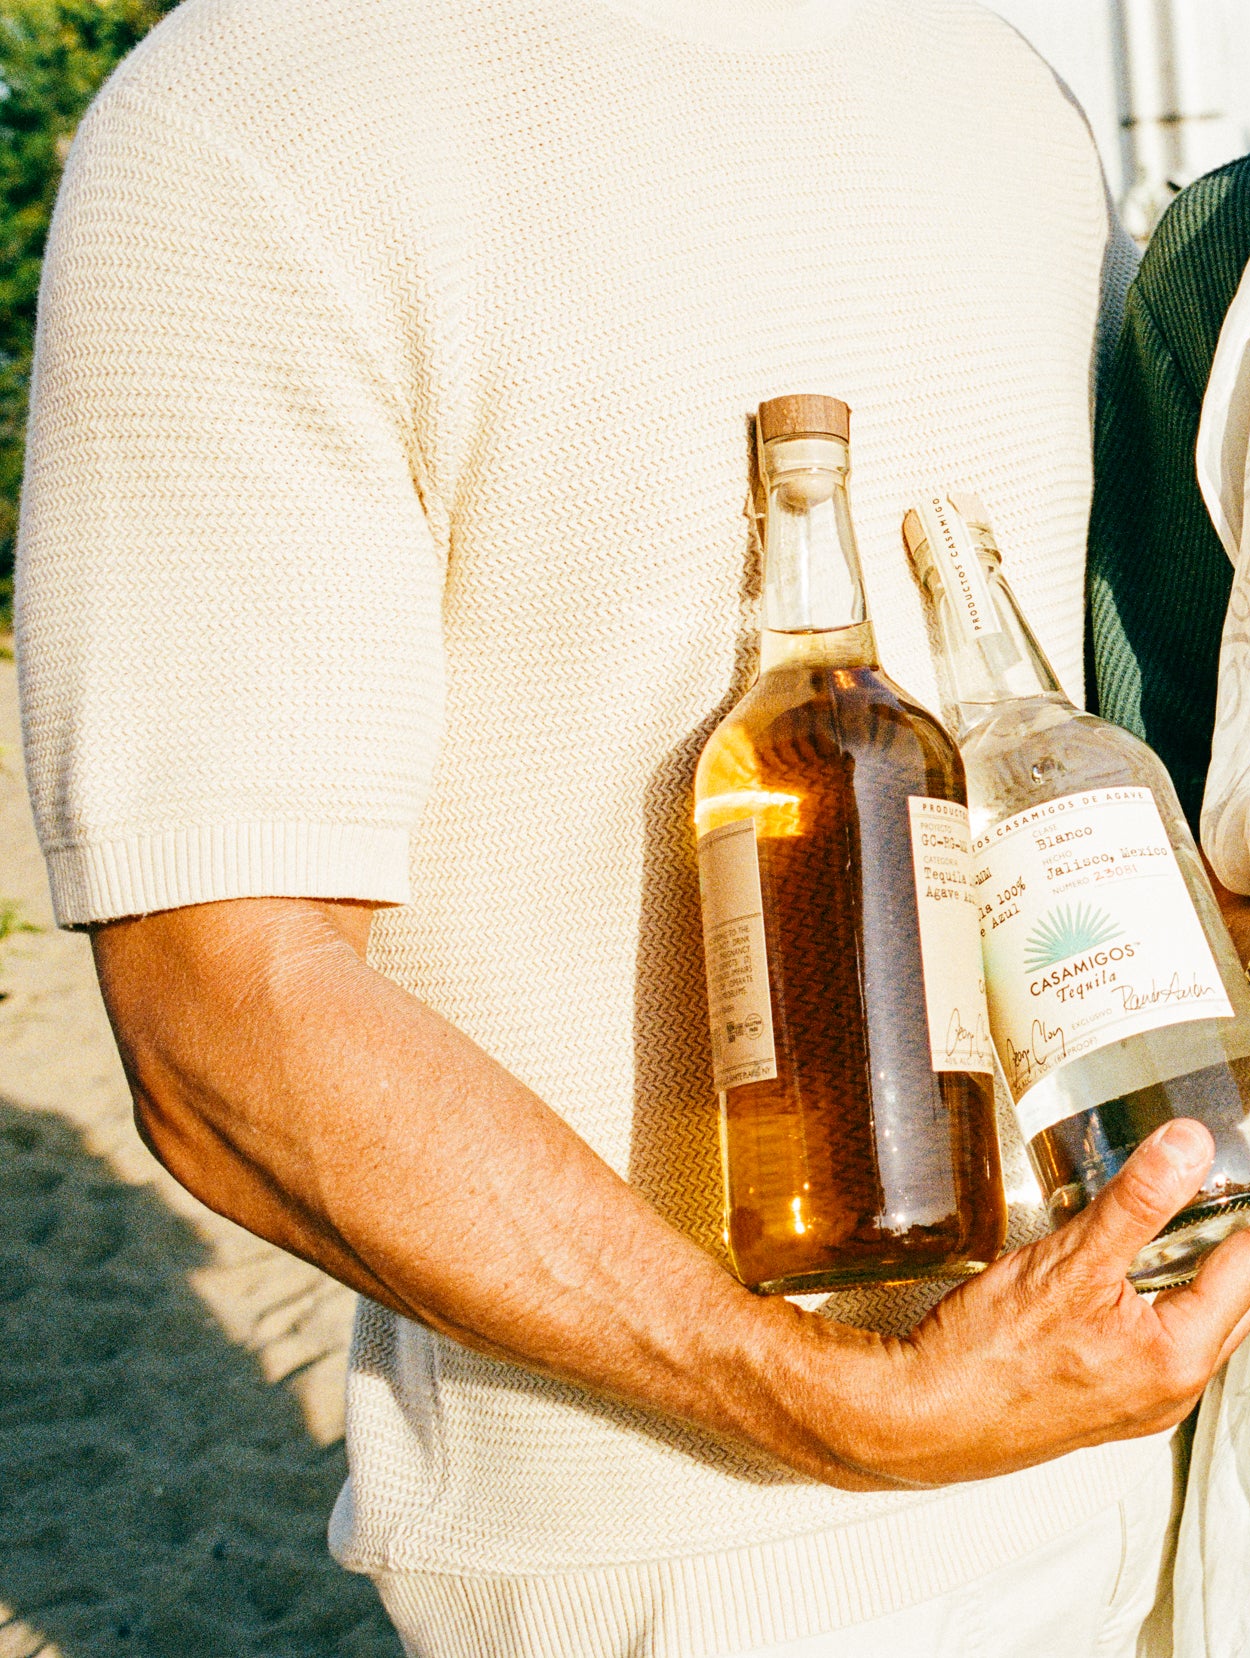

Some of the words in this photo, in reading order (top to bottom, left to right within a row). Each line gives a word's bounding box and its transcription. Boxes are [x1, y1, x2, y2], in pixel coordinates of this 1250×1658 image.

[955, 564, 981, 631] PRODUCTOS
[996, 800, 1075, 837] CASAMIGOS
[1082, 796, 1098, 806] DE
[1106, 791, 1144, 801] AGAVE
[1032, 824, 1057, 839] CLASE
[1035, 826, 1093, 851] Blanco
[1042, 850, 1073, 866] HECHO
[1046, 852, 1115, 881] Jalisco,
[1121, 845, 1168, 860] Mexico
[924, 866, 967, 884] Tequila
[926, 885, 959, 901] Agave
[997, 876, 1027, 906] 100%
[991, 903, 1021, 930] Azul
[1029, 944, 1136, 997] CASAMIGOS
[1056, 970, 1118, 1004] Tequila
